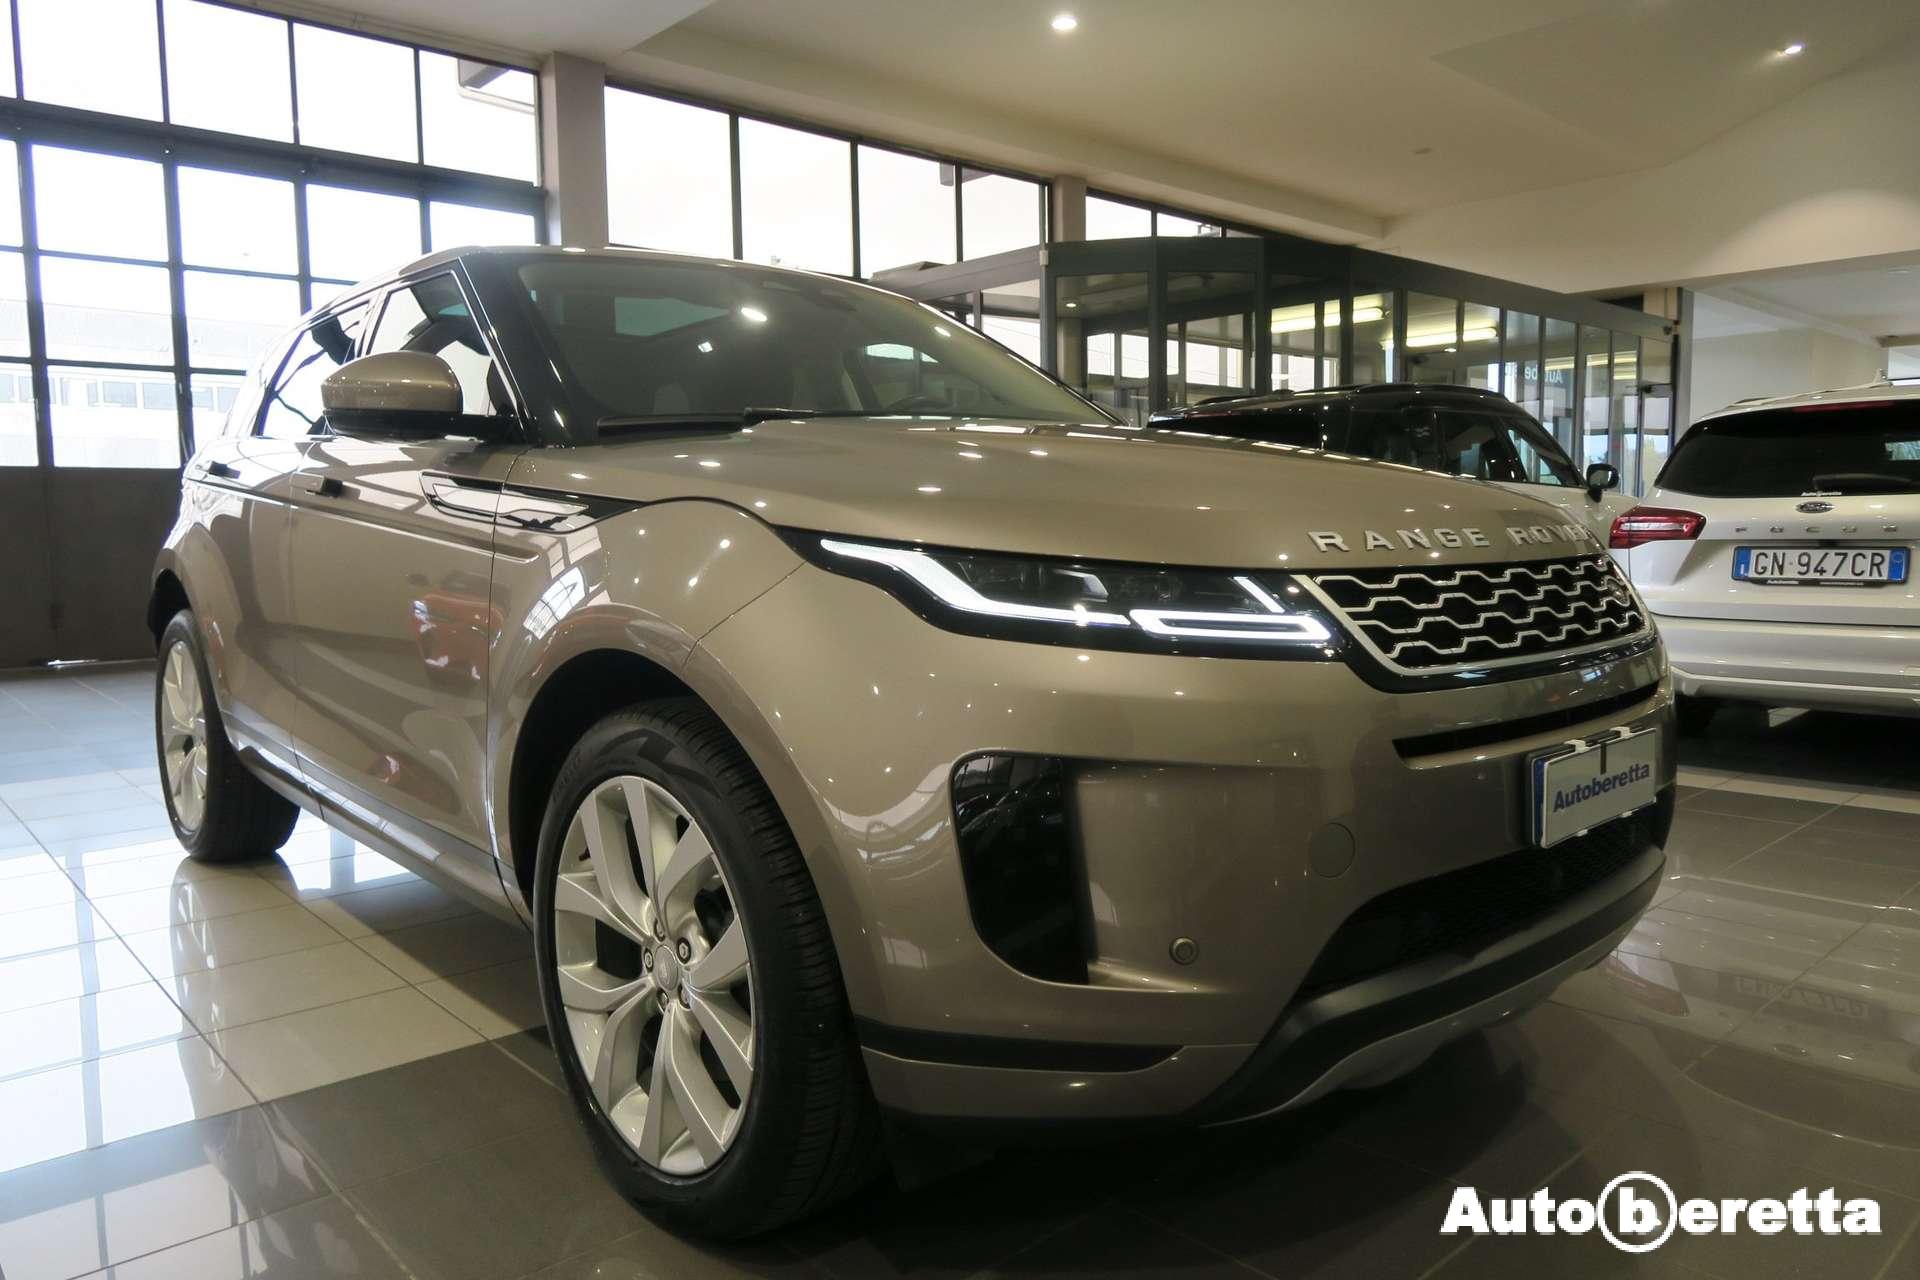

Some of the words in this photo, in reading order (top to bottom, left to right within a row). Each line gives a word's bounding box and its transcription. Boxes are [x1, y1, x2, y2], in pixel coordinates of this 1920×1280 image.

[1308, 528, 1490, 552] RANGE
[1754, 552, 1786, 576] GN
[1797, 552, 1886, 577] 947CR
[1553, 763, 1650, 812] Autoberetta
